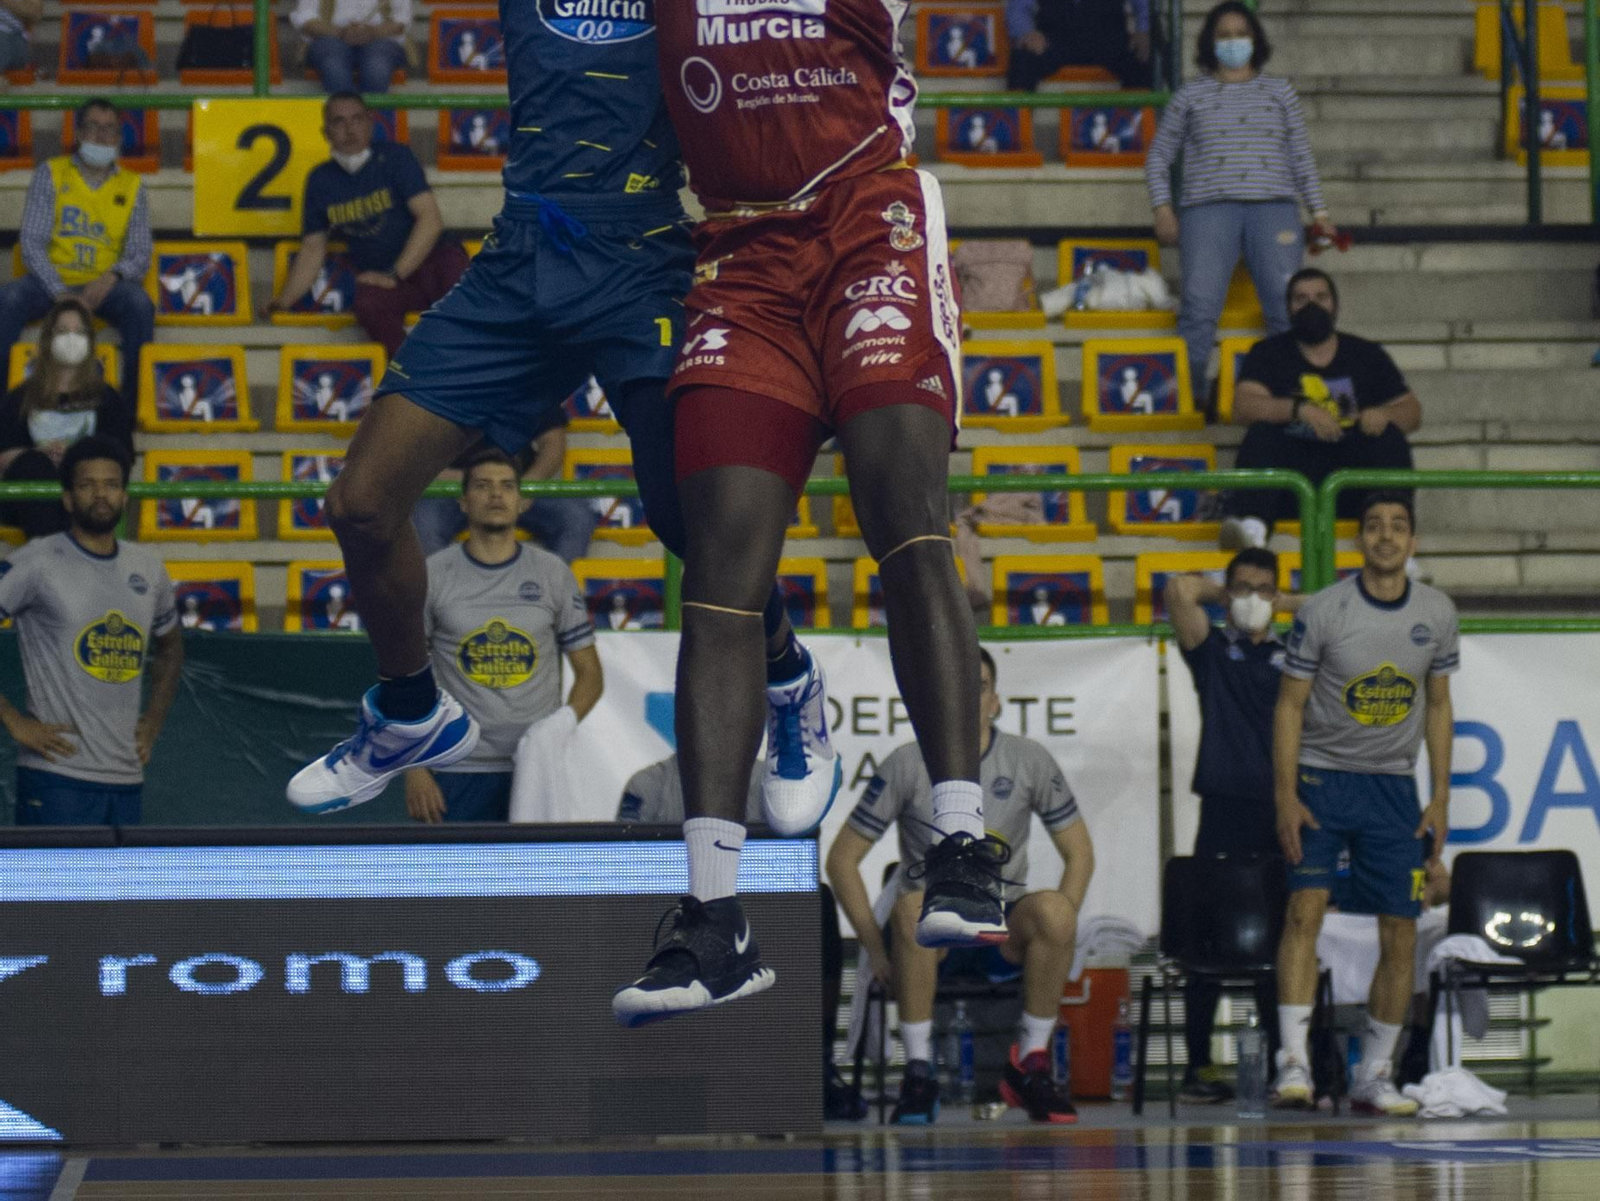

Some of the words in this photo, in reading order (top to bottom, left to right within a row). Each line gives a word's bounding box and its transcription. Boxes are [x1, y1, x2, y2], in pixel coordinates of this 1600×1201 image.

[697, 15, 826, 46] Murcia
[731, 72, 789, 93] Costa
[794, 66, 858, 88] Cálida
[233, 123, 292, 211] 2
[844, 275, 918, 301] CRC
[97, 949, 541, 996] romo
